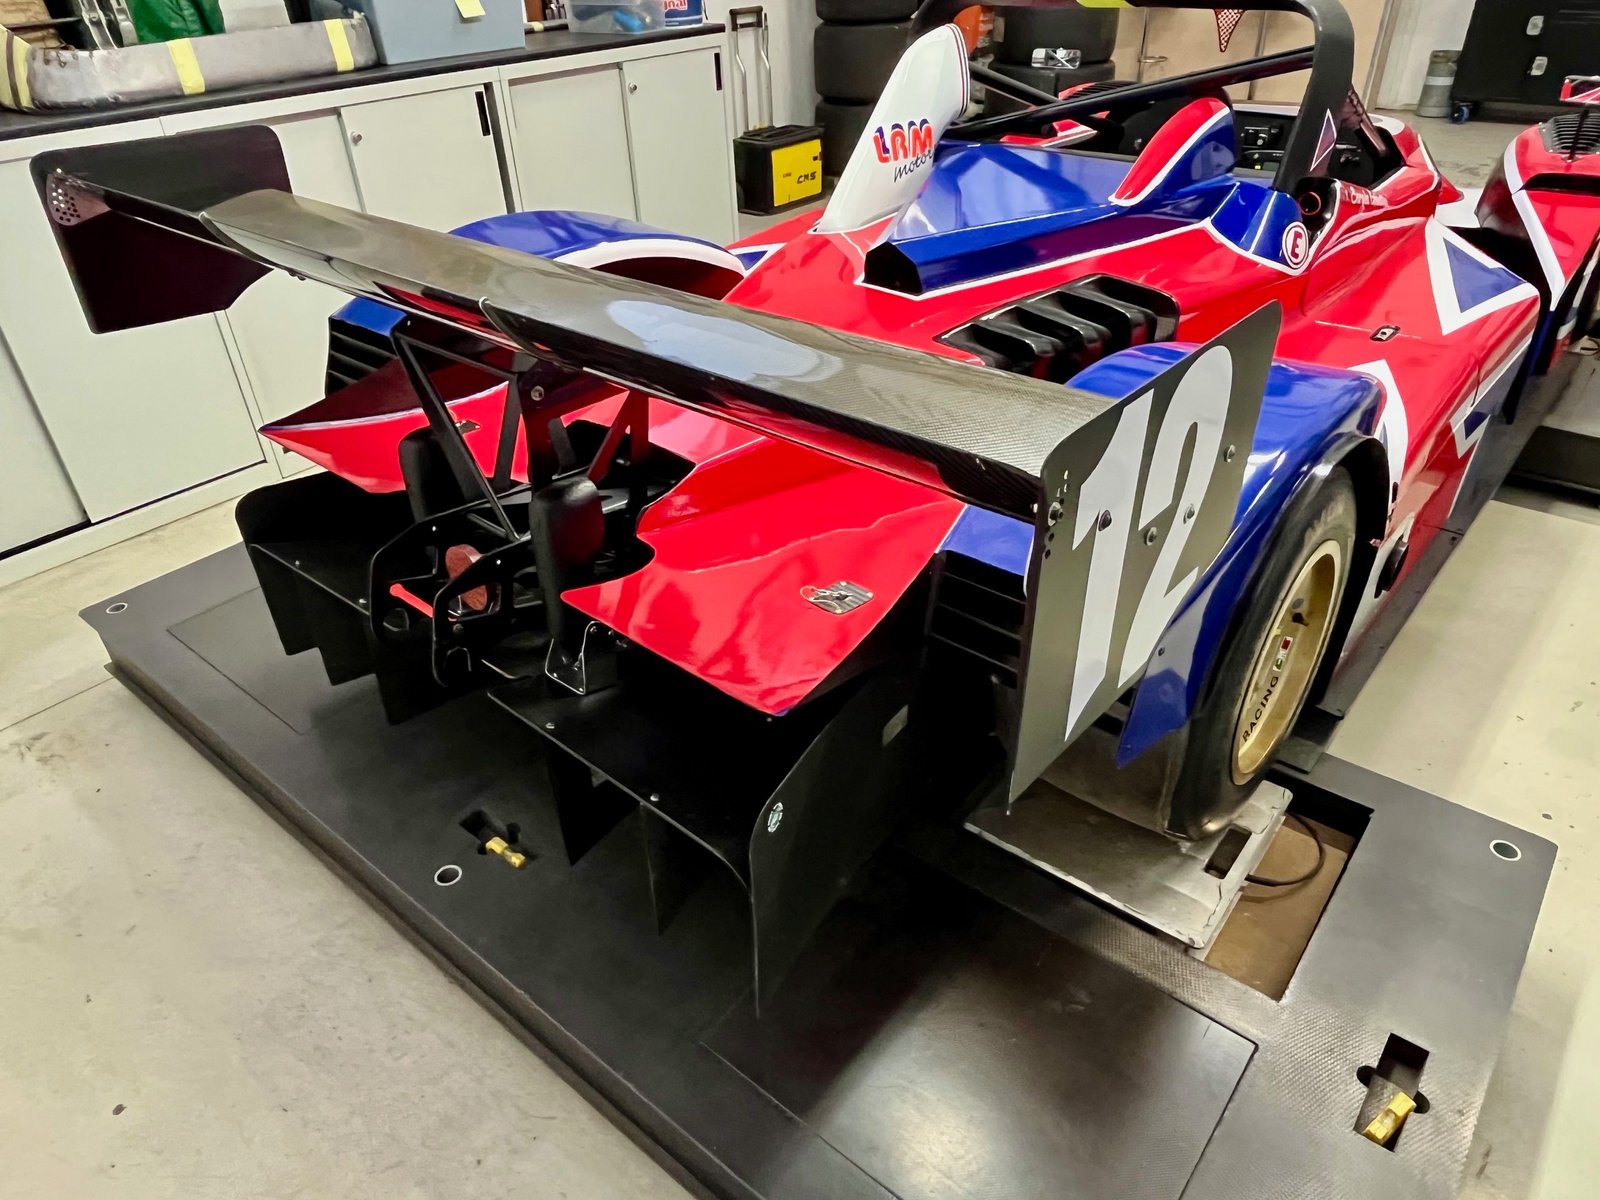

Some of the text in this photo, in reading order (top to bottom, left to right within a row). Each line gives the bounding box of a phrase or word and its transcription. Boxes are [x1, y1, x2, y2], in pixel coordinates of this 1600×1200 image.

[873, 119, 933, 163] LRM
[1291, 230, 1303, 260] E
[1064, 345, 1233, 742] 12
[1242, 676, 1279, 742] RACING
